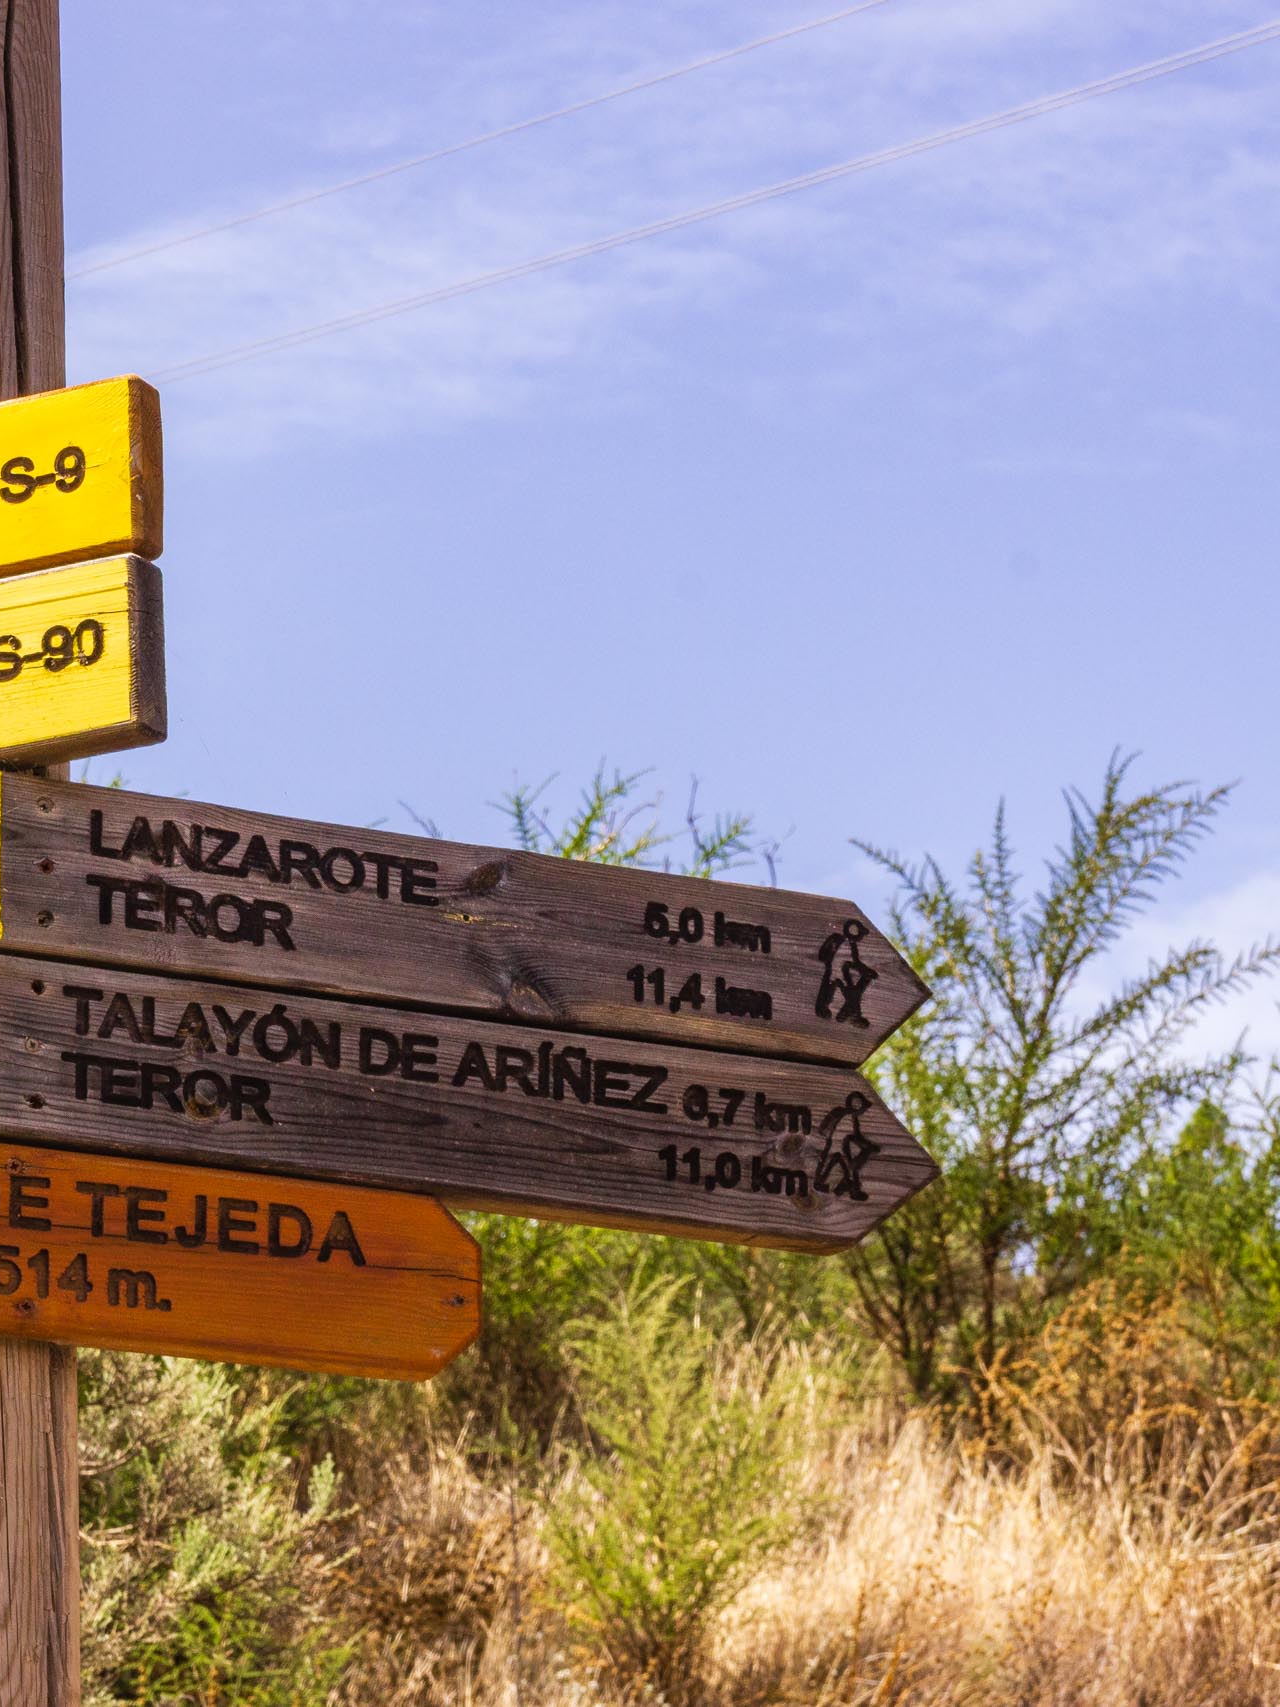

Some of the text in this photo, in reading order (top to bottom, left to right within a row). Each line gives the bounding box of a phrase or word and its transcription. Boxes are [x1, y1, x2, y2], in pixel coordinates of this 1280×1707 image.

[0, 446, 85, 504] S-9
[89, 808, 440, 906] LANZAROTE
[86, 873, 297, 951] TEROR
[714, 911, 772, 954] km
[63, 984, 668, 1114] TALAYÓN DE ARÍÑEZ
[60, 1050, 274, 1126] TEROR
[753, 1093, 812, 1136] km
[751, 1155, 809, 1198] km
[75, 1180, 367, 1268] TEJEDA
[107, 1266, 172, 1314] m.
